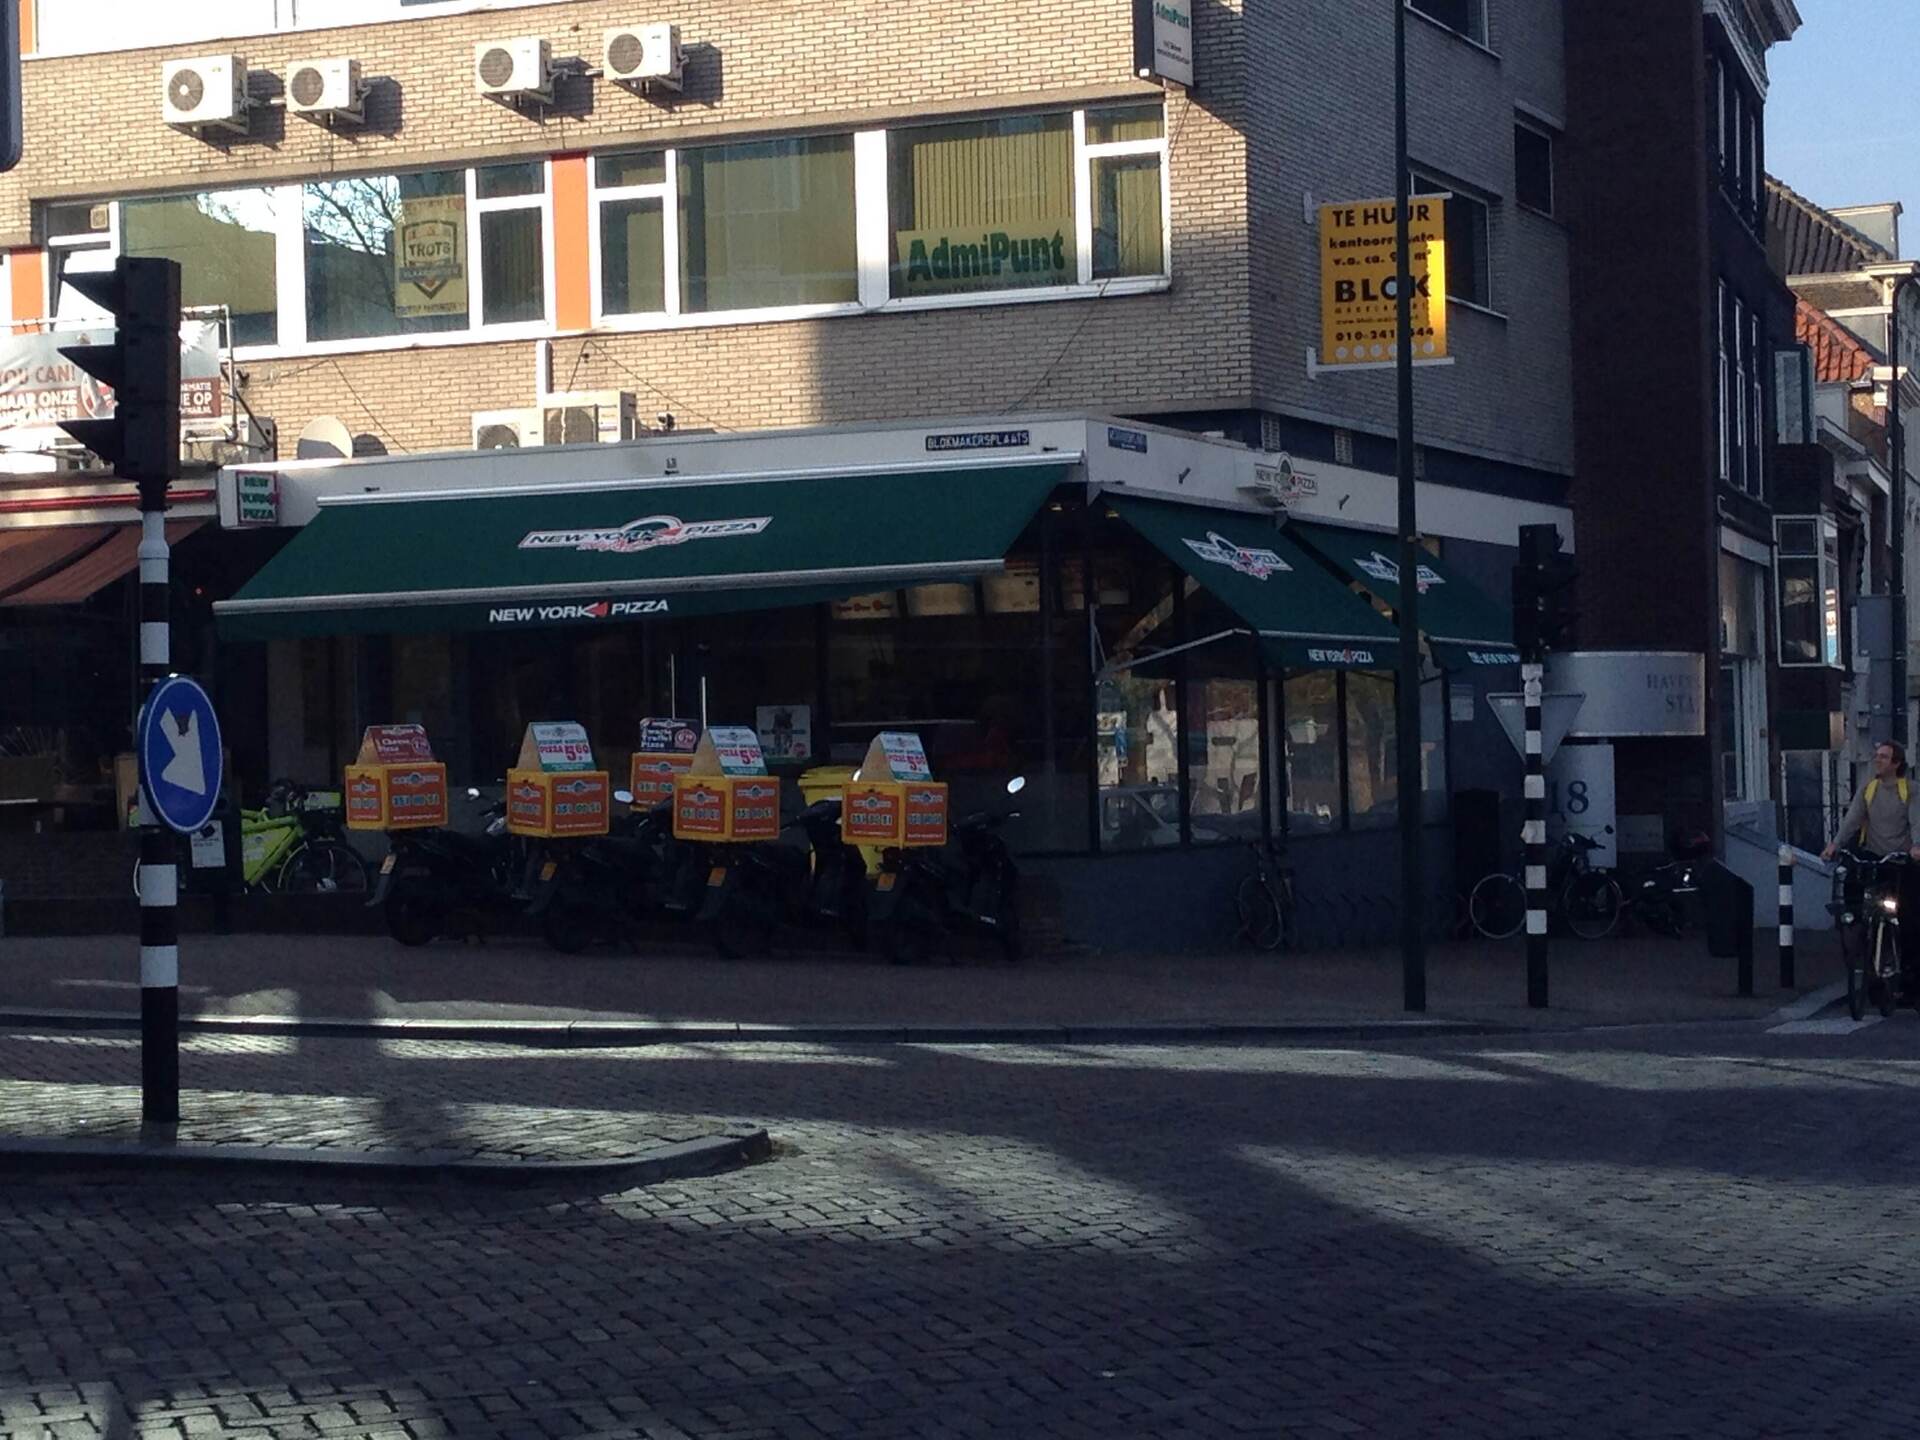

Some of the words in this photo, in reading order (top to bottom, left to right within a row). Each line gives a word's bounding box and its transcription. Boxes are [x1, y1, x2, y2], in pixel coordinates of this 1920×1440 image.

[1331, 210, 1355, 228] TE
[907, 229, 1065, 282] AdmiPunt
[1334, 275, 1430, 303] BLOK
[36, 364, 76, 383] CAN!
[39, 389, 78, 407] ONZE
[193, 392, 212, 406] OP
[244, 476, 268, 487] NEW
[243, 508, 274, 519] PIZZA
[528, 533, 591, 544] NEW
[685, 522, 758, 535] PIZZA
[489, 607, 535, 622] NEW
[537, 602, 604, 621] YORK
[611, 599, 669, 616] PIZZA
